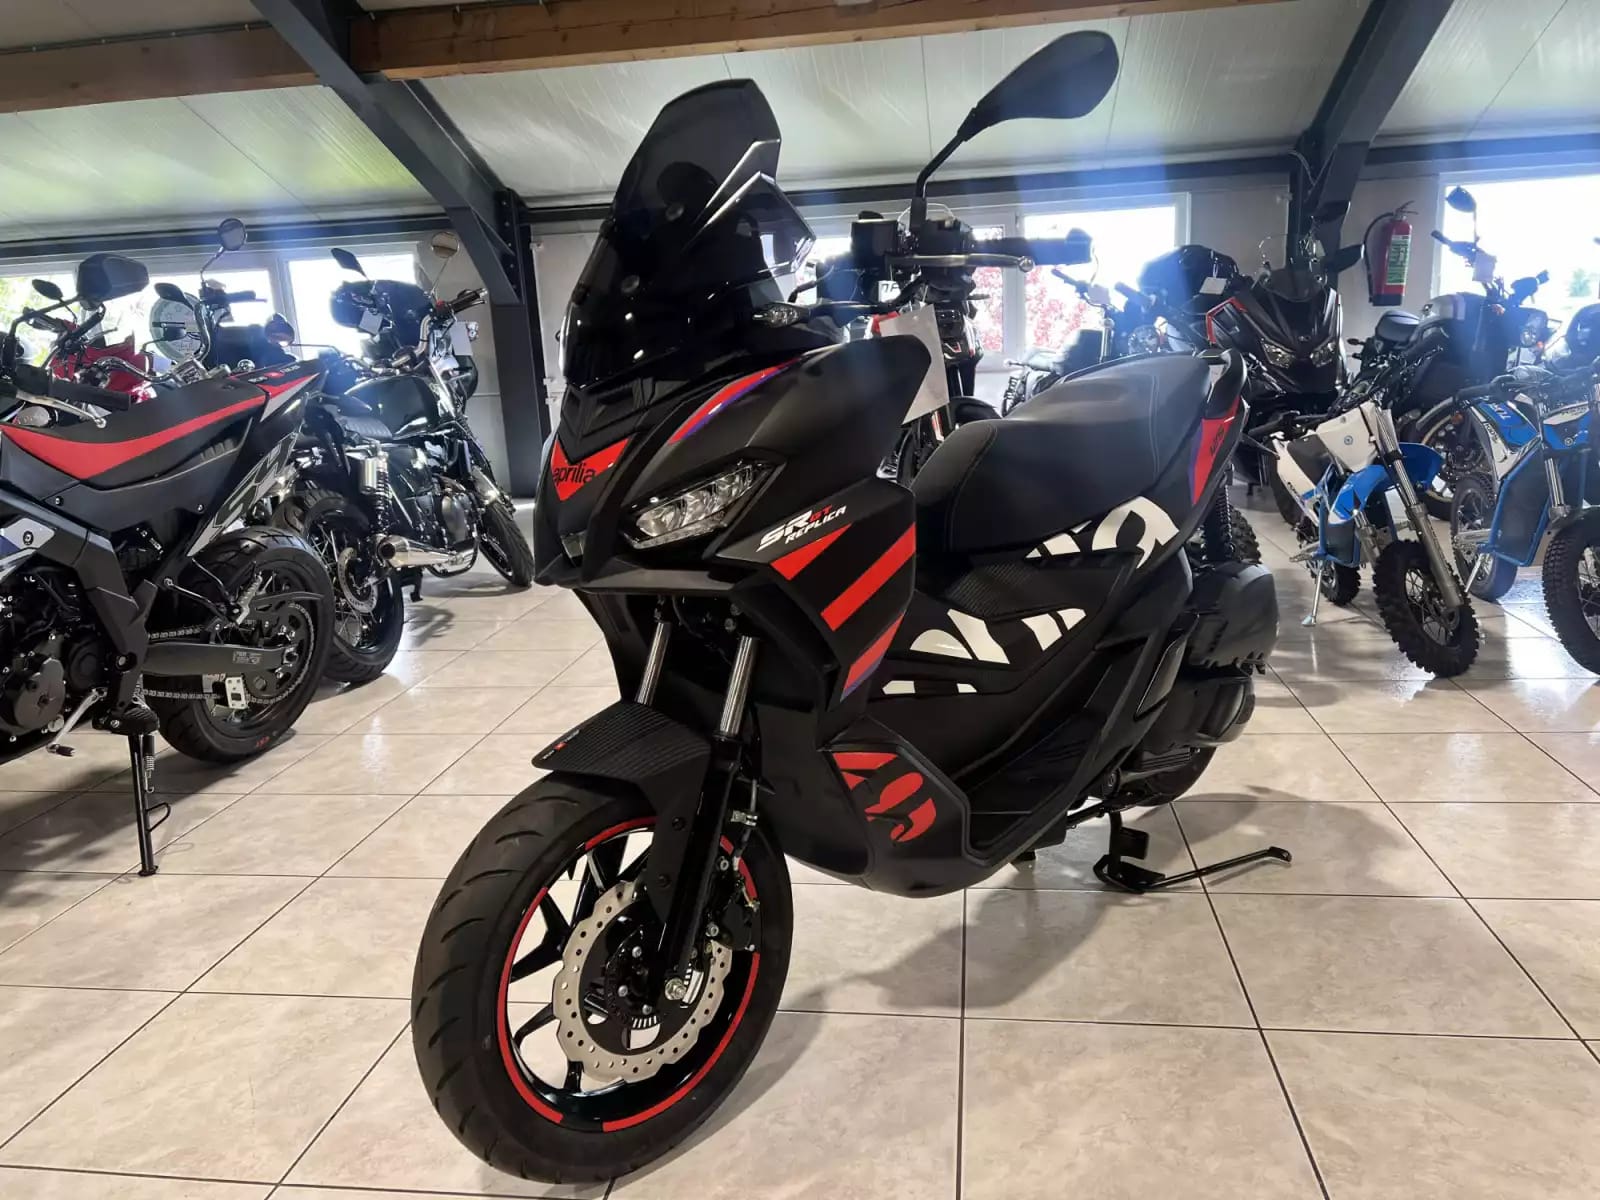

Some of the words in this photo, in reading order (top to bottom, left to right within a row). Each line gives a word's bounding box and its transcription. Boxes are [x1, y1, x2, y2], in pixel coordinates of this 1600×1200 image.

[552, 463, 597, 487] aprilia
[755, 510, 813, 552] SR
[808, 504, 833, 523] GT
[784, 505, 847, 545] REPLICA
